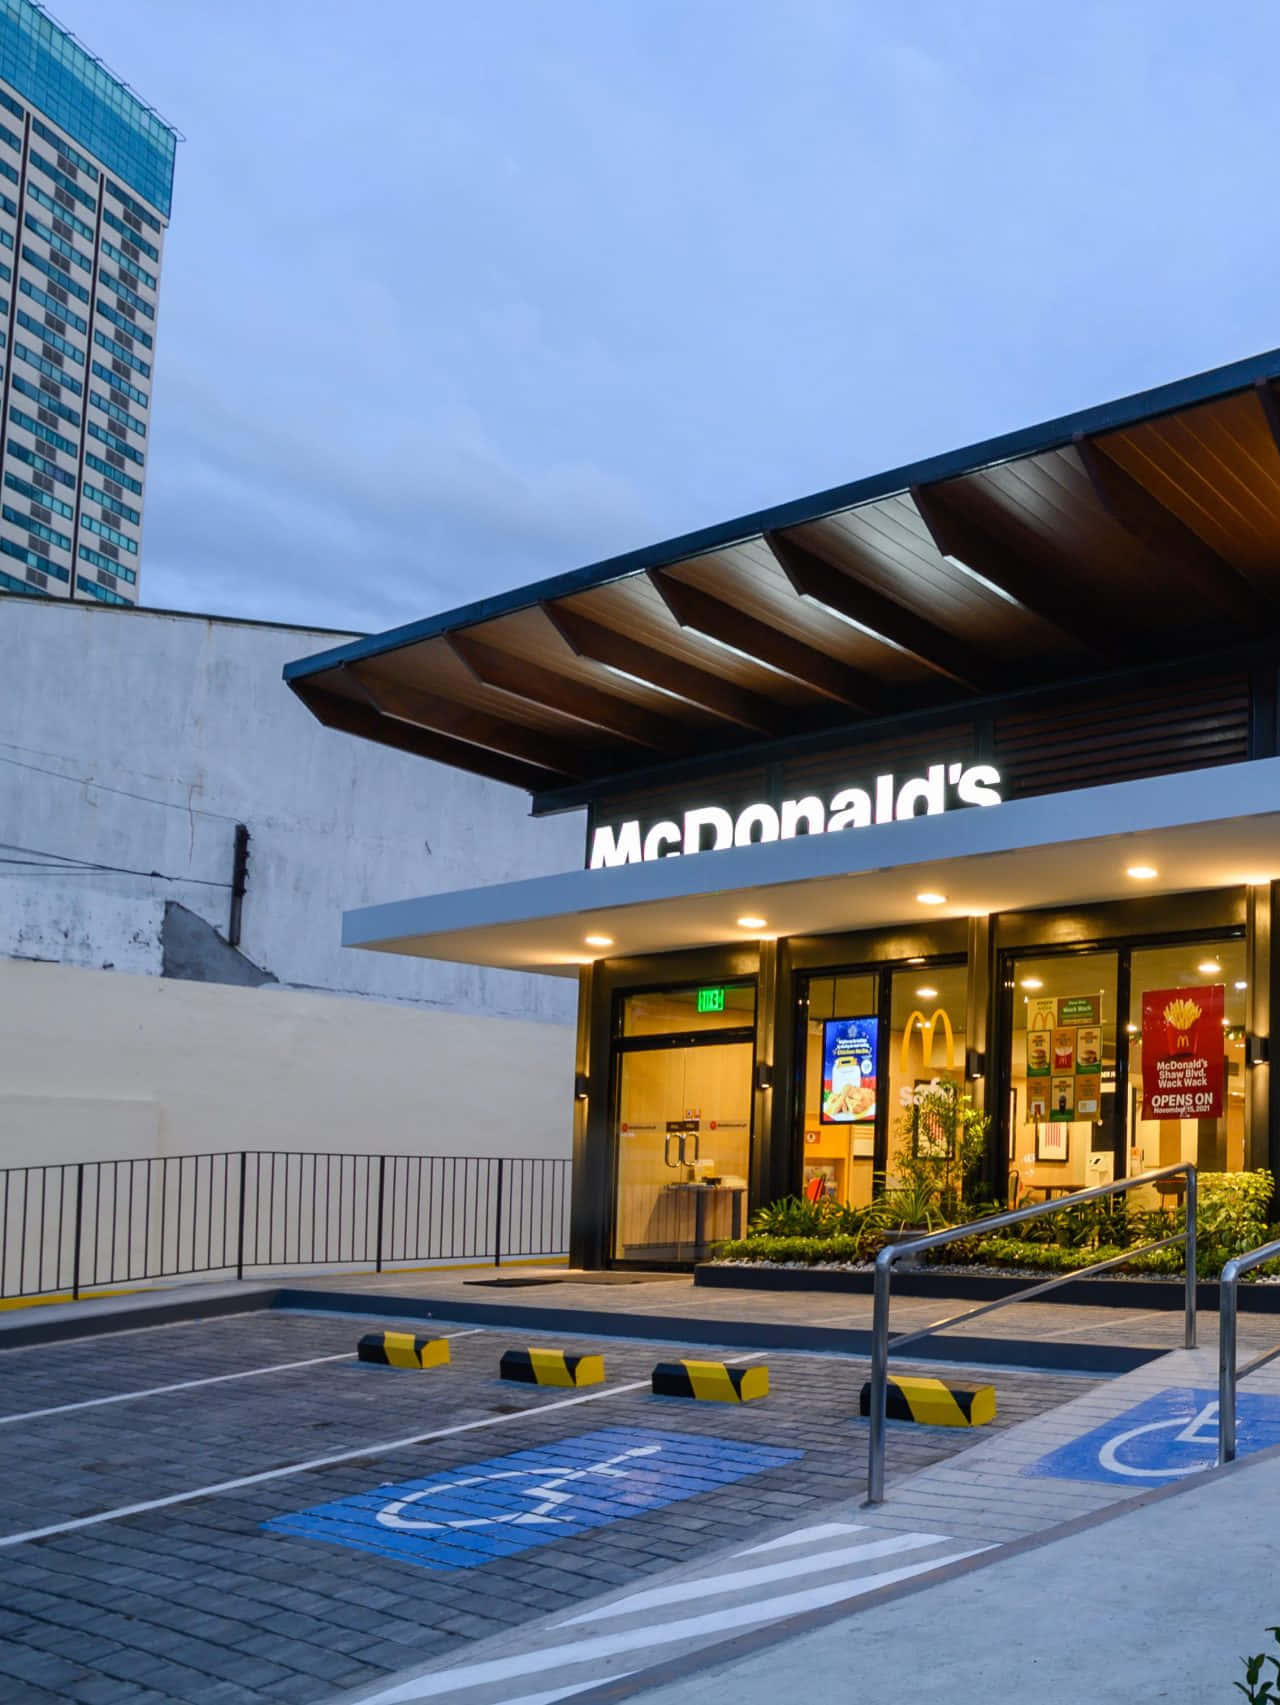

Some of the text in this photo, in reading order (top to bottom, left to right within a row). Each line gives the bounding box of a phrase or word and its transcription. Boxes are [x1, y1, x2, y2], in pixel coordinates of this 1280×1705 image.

[589, 762, 1002, 870] McDonald's
[1157, 1059, 1208, 1071] McDonald's
[1159, 1068, 1206, 1079] Shaw Blvd.
[1158, 1077, 1208, 1088] Wack Wack
[1151, 1091, 1214, 1107] OPENS ON
